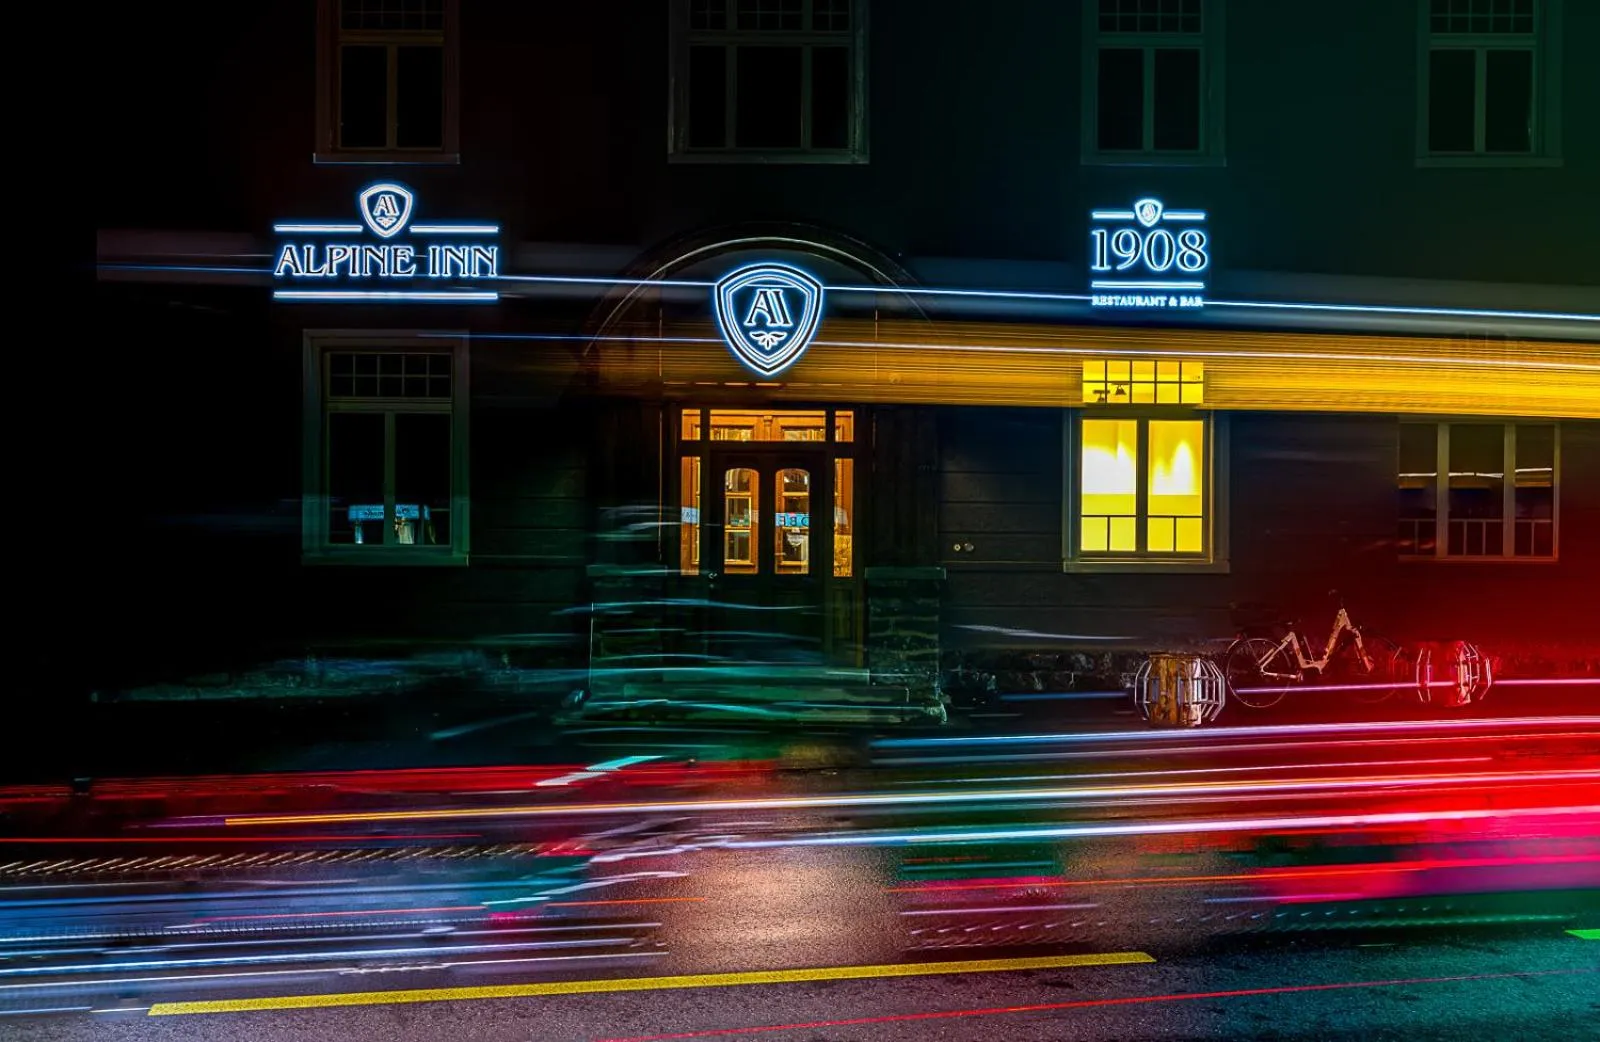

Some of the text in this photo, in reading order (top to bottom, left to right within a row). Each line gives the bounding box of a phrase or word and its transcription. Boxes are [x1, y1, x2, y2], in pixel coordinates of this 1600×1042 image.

[274, 244, 499, 278] ALPINE INN
[1091, 229, 1208, 272] 1908
[1091, 295, 1204, 307] RESTAURANT & BAR
